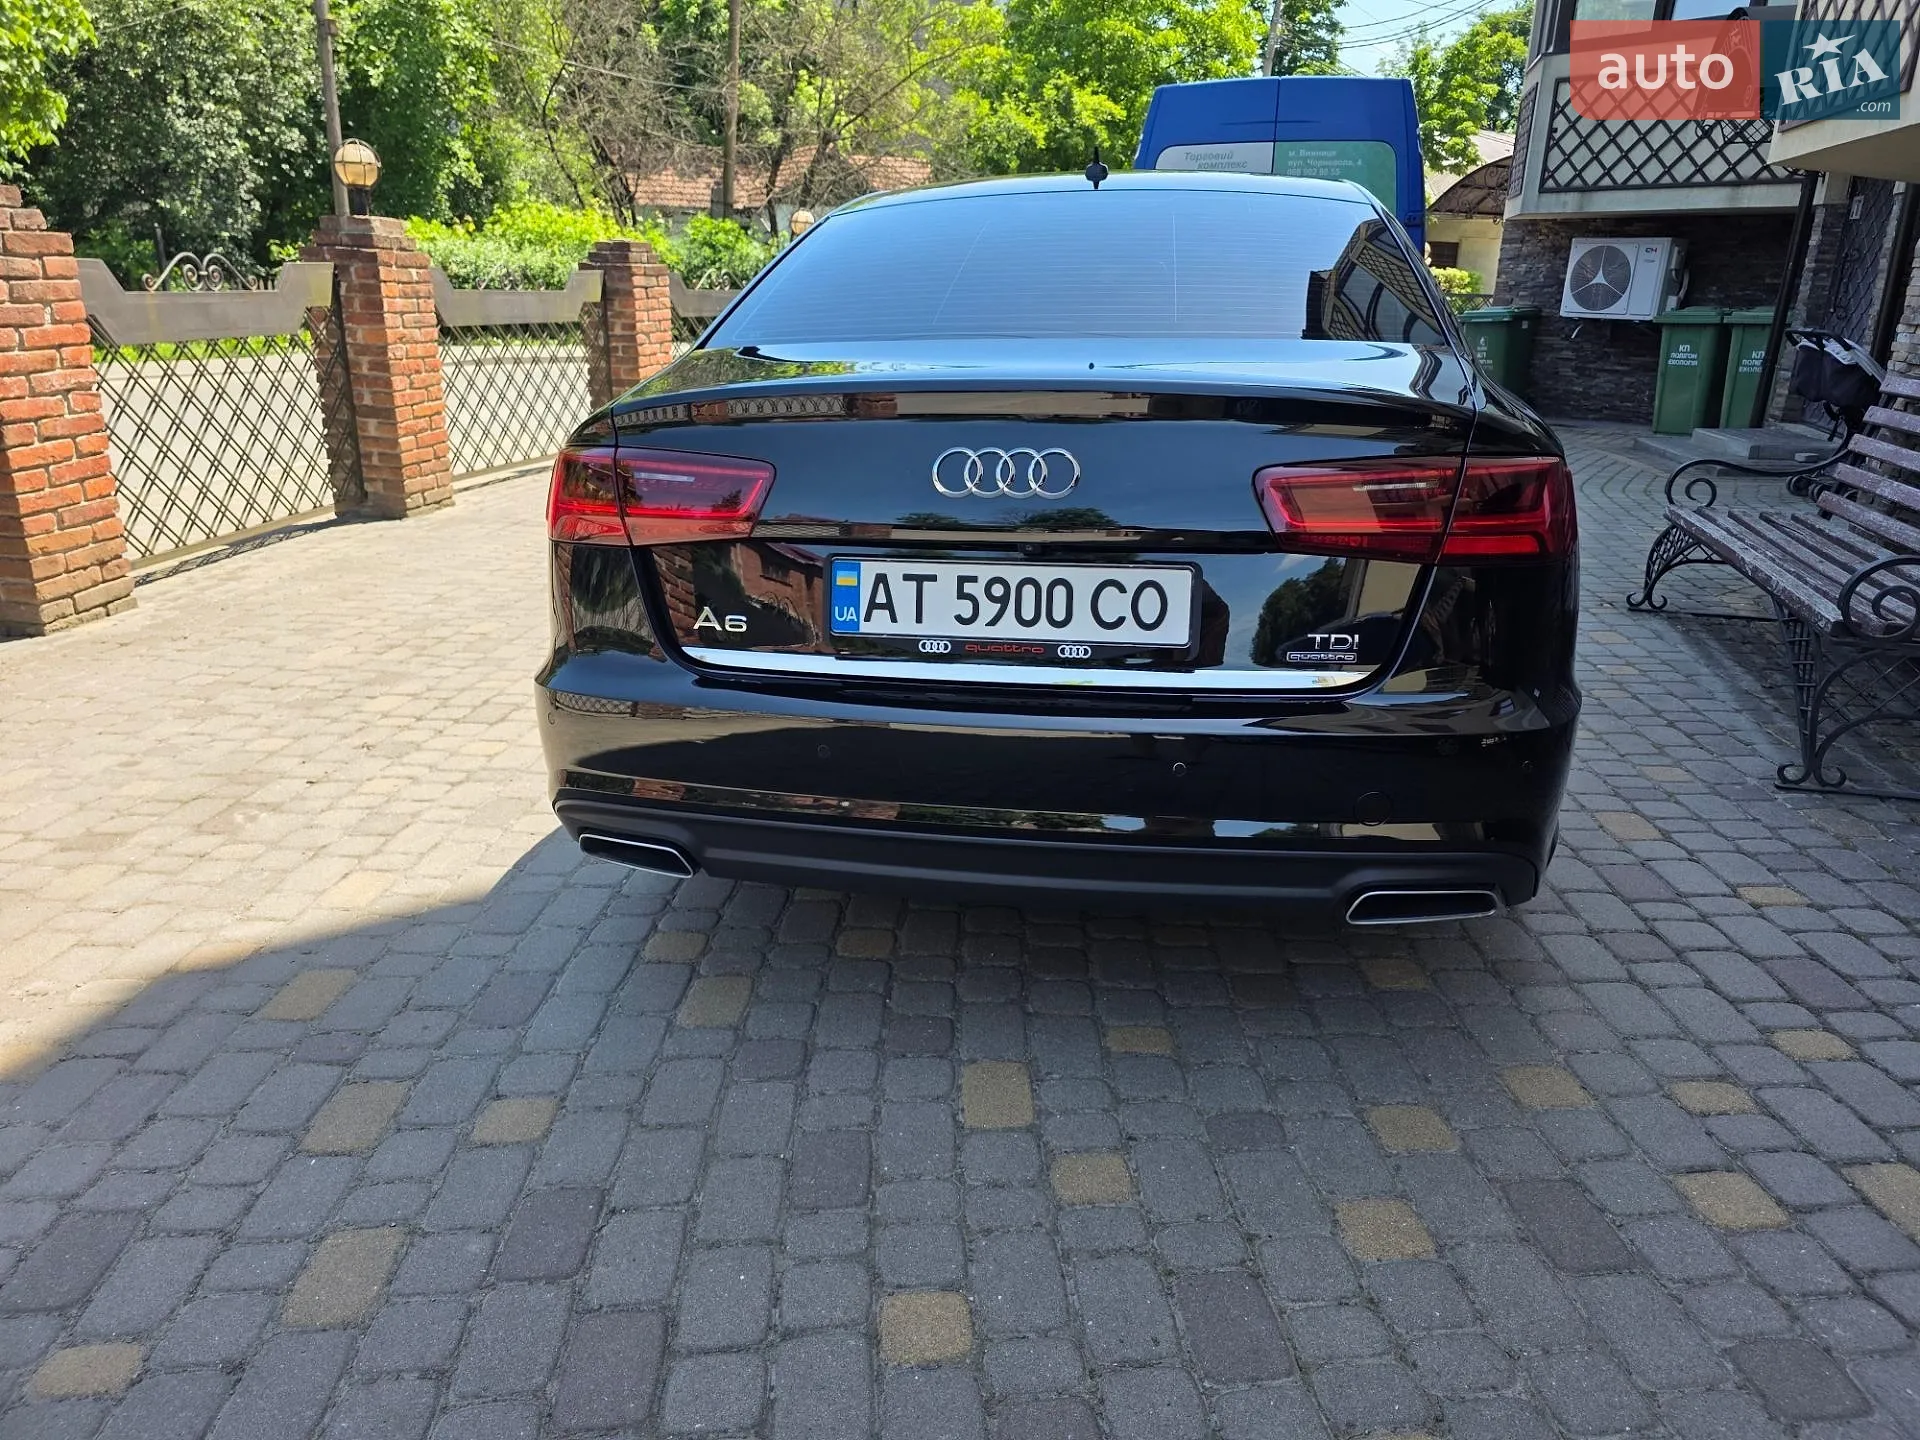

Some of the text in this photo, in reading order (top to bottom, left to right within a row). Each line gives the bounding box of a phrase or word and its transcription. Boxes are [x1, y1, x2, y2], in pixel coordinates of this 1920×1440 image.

[1678, 344, 1690, 352] КП
[863, 572, 1168, 631] AT 5900 CO
[693, 606, 747, 632] A6
[834, 606, 857, 622] UA
[964, 643, 1044, 655] quattro
[1307, 634, 1359, 650] TDI
[1290, 653, 1354, 662] quattro
